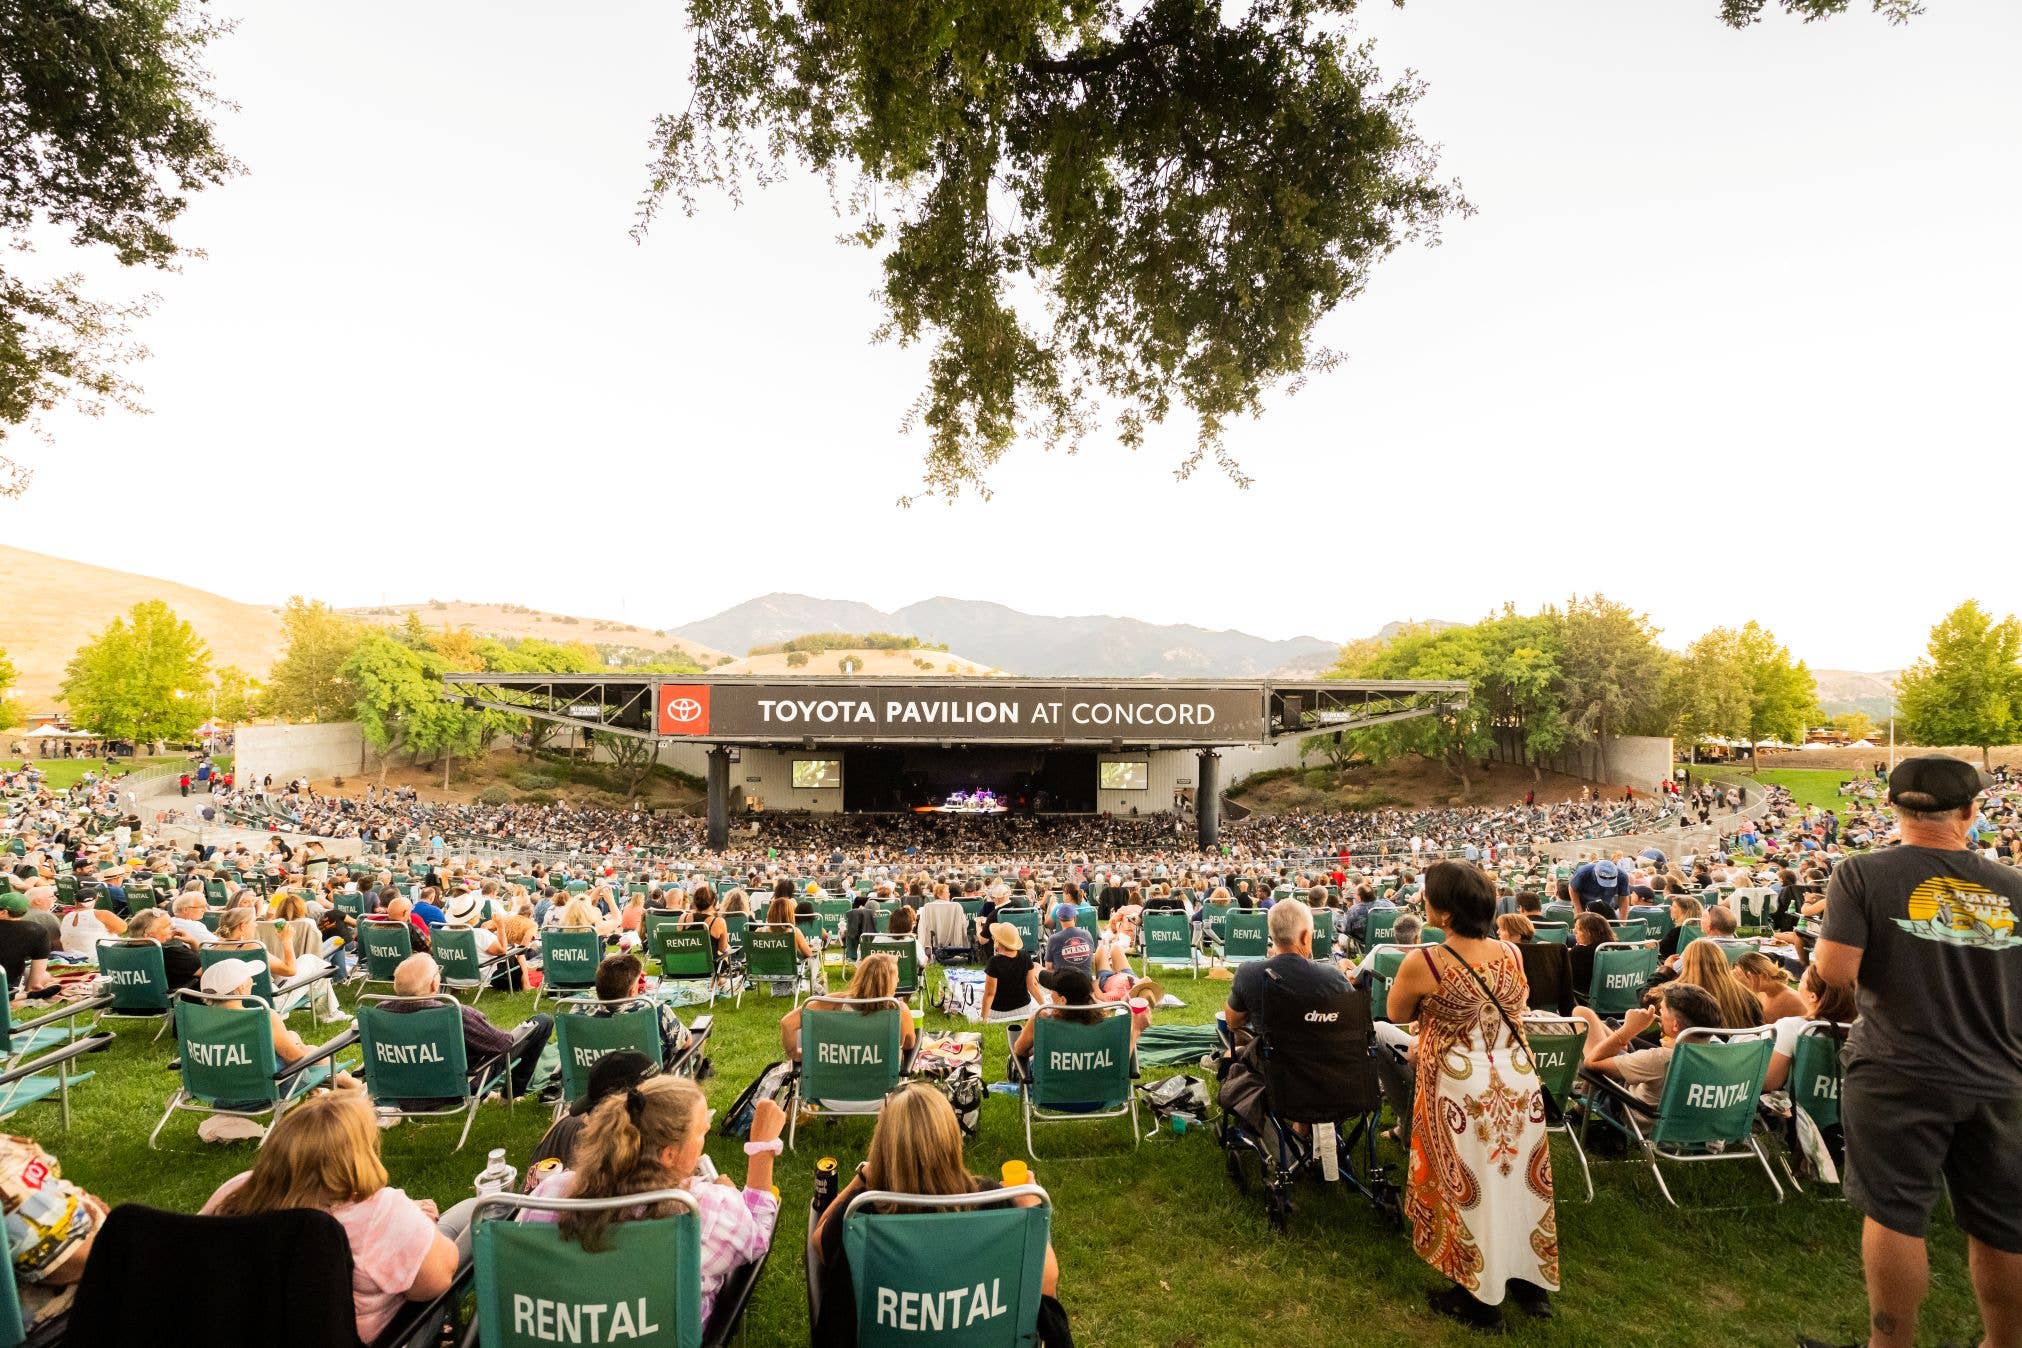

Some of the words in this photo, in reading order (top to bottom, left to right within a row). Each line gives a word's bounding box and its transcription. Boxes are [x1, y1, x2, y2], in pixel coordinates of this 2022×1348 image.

[758, 700, 876, 723] TOYOTA
[886, 701, 1019, 724] PAVILION
[1031, 702, 1062, 724] AT
[1071, 703, 1215, 725] CONCORD
[337, 904, 357, 913] RENTAL
[1209, 915, 1226, 924] RENT
[1152, 930, 1182, 941] RENTAL
[1232, 928, 1262, 939] RENTAL
[1375, 928, 1396, 938] RENT
[666, 938, 703, 948] RENTAL
[752, 940, 788, 948] RENTAL
[370, 944, 401, 958] RENTAL
[437, 946, 467, 960] RENTAL
[552, 948, 589, 962] RENTAL
[1606, 972, 1645, 989] RENTAL
[1304, 1009, 1339, 1022] drive
[187, 1039, 252, 1066] RENTAL
[375, 1041, 445, 1065] RENTAL
[818, 1042, 883, 1065] RENTAL
[1050, 1048, 1114, 1071] RENTAL
[1534, 1051, 1566, 1068] TAL
[1686, 1080, 1751, 1109] RENTAL
[877, 1277, 1008, 1332] RENTAL
[513, 1293, 659, 1344] RENTAL
